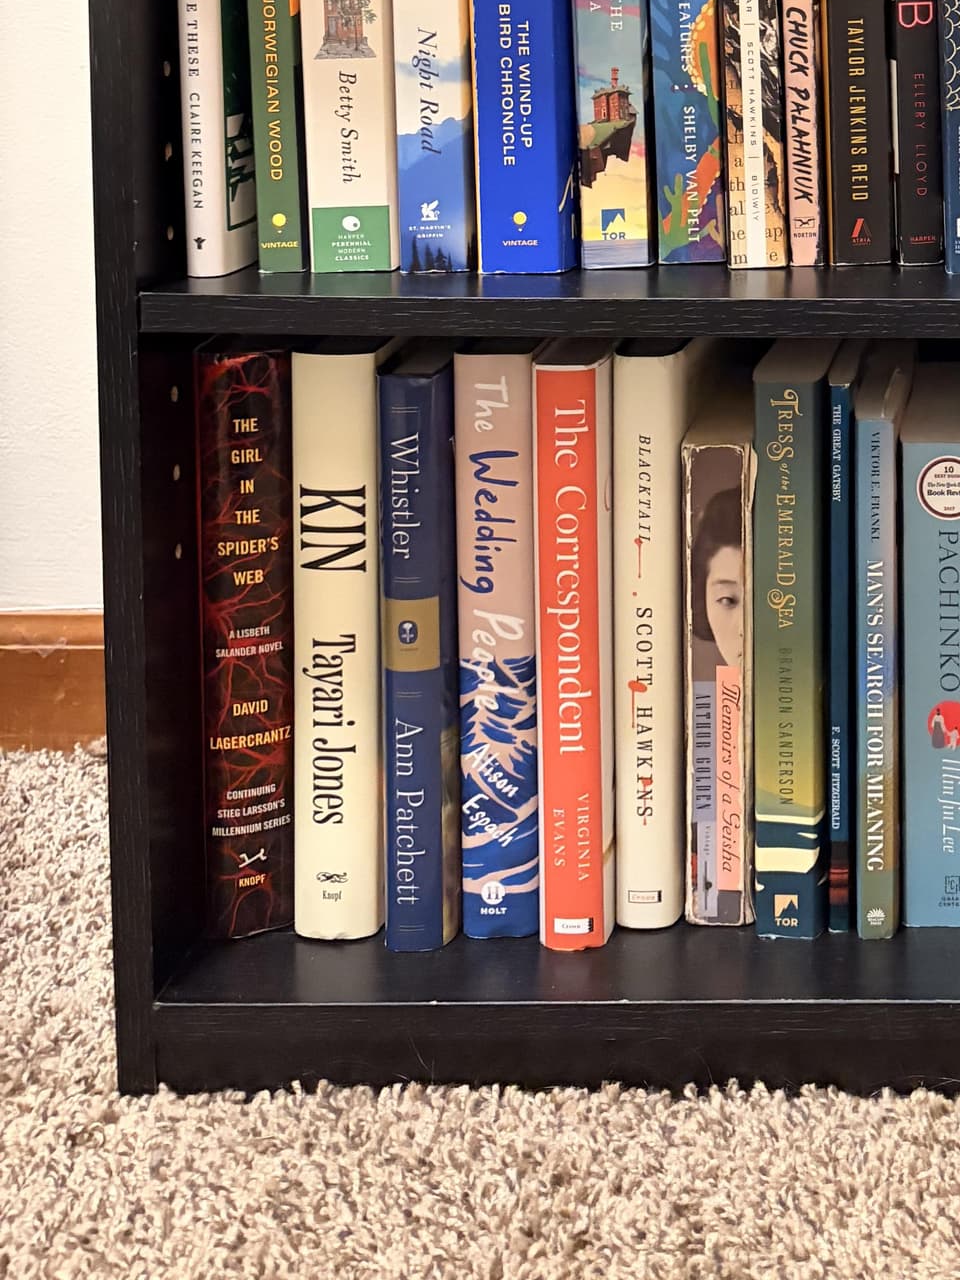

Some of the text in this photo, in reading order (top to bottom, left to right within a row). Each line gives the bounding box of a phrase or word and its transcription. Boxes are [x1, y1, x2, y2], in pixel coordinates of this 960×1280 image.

[186, 19, 199, 77] THESE
[411, 27, 441, 155] Night Road
[268, 120, 283, 181] WOOD
[334, 70, 361, 183] Betty Smith
[261, 240, 299, 248] VINTAGE
[602, 232, 626, 240] TOR
[233, 418, 258, 433] THE
[832, 404, 842, 502] THE GREAT GATSBY
[231, 448, 263, 464] GIRL
[944, 466, 954, 474] 10
[240, 480, 254, 494] IN
[390, 432, 421, 560] Whistler
[638, 435, 651, 542] BLACKTAIL
[927, 489, 945, 497] Book
[217, 536, 279, 556] SPIDER'S
[235, 509, 260, 526] THE
[300, 484, 366, 573] KIN
[459, 376, 525, 712] The Wedding People
[233, 569, 264, 586] WEB
[546, 399, 592, 756] The Correspondent
[938, 530, 960, 692] PACHINKO
[210, 725, 291, 750] LAGERCRANTZ
[302, 634, 356, 825] Tayari Jones
[779, 647, 794, 805] BRANDON SANDERSON
[866, 560, 884, 871] MAN'S SEARCH FOR MEANING
[212, 814, 291, 837] MILLENNIUM SERIES
[394, 718, 425, 905] Ann Patchett
[553, 808, 565, 867] EVANS
[576, 793, 591, 881] VIRGINIA
[239, 874, 266, 888] KNOPF
[480, 907, 507, 915] HOLT
[775, 917, 799, 927] TOR
